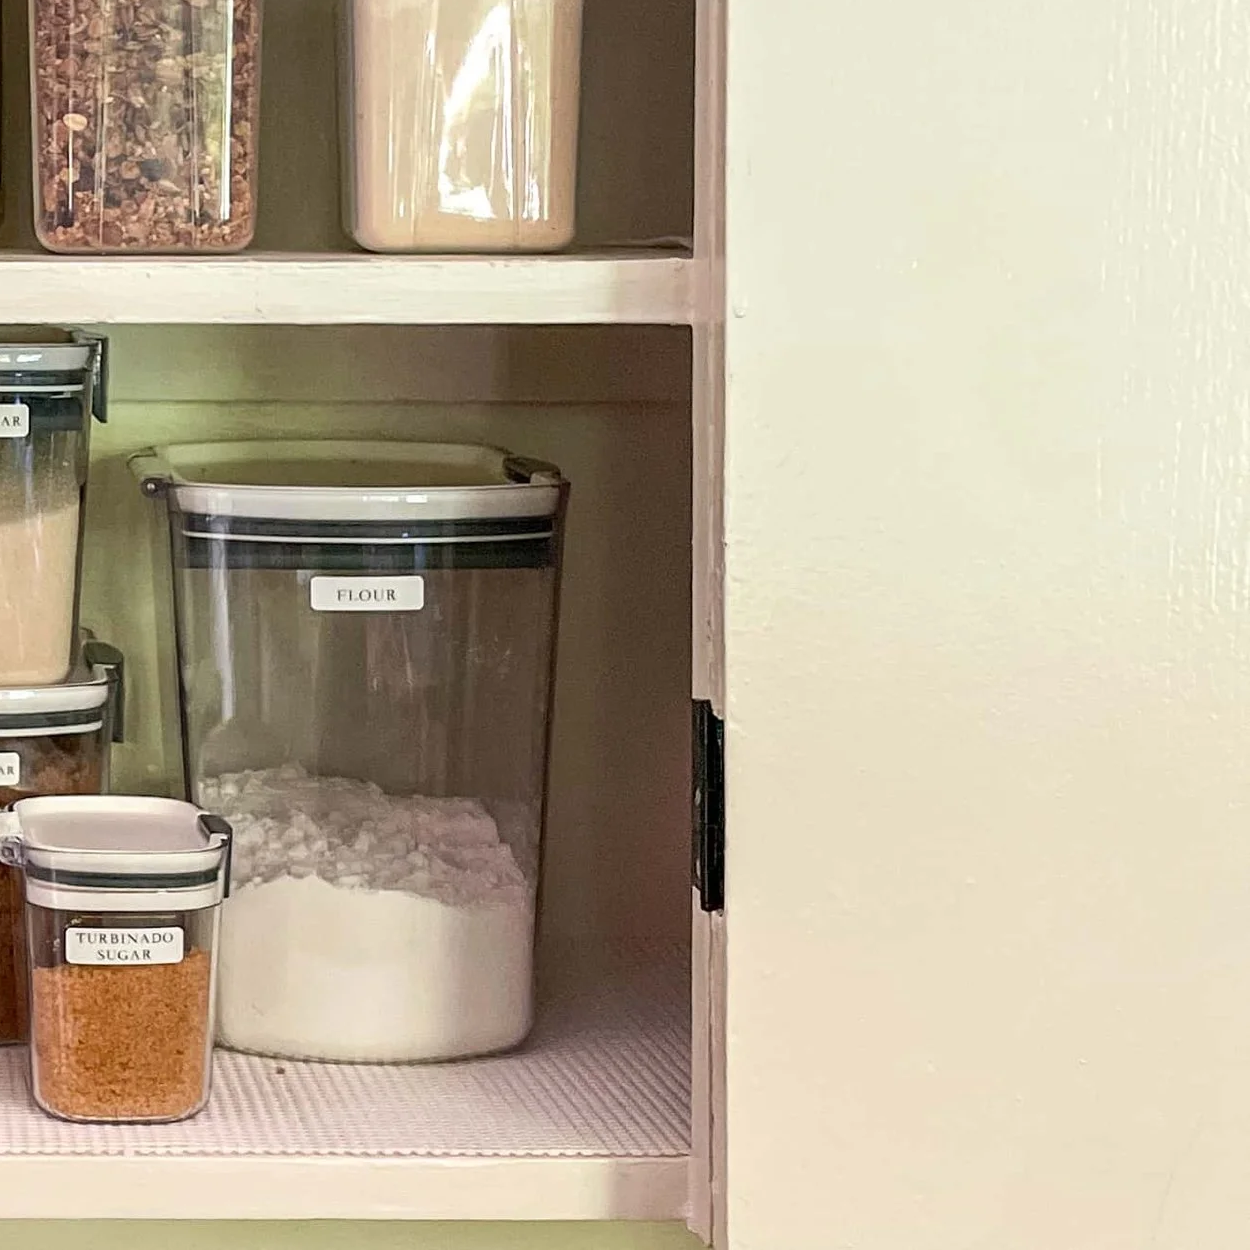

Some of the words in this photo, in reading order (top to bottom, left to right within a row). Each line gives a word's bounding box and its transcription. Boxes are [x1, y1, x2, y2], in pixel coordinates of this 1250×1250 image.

[337, 589, 397, 602] FLOUR
[76, 932, 174, 945] TURBINADO
[97, 949, 152, 961] SUGAR
